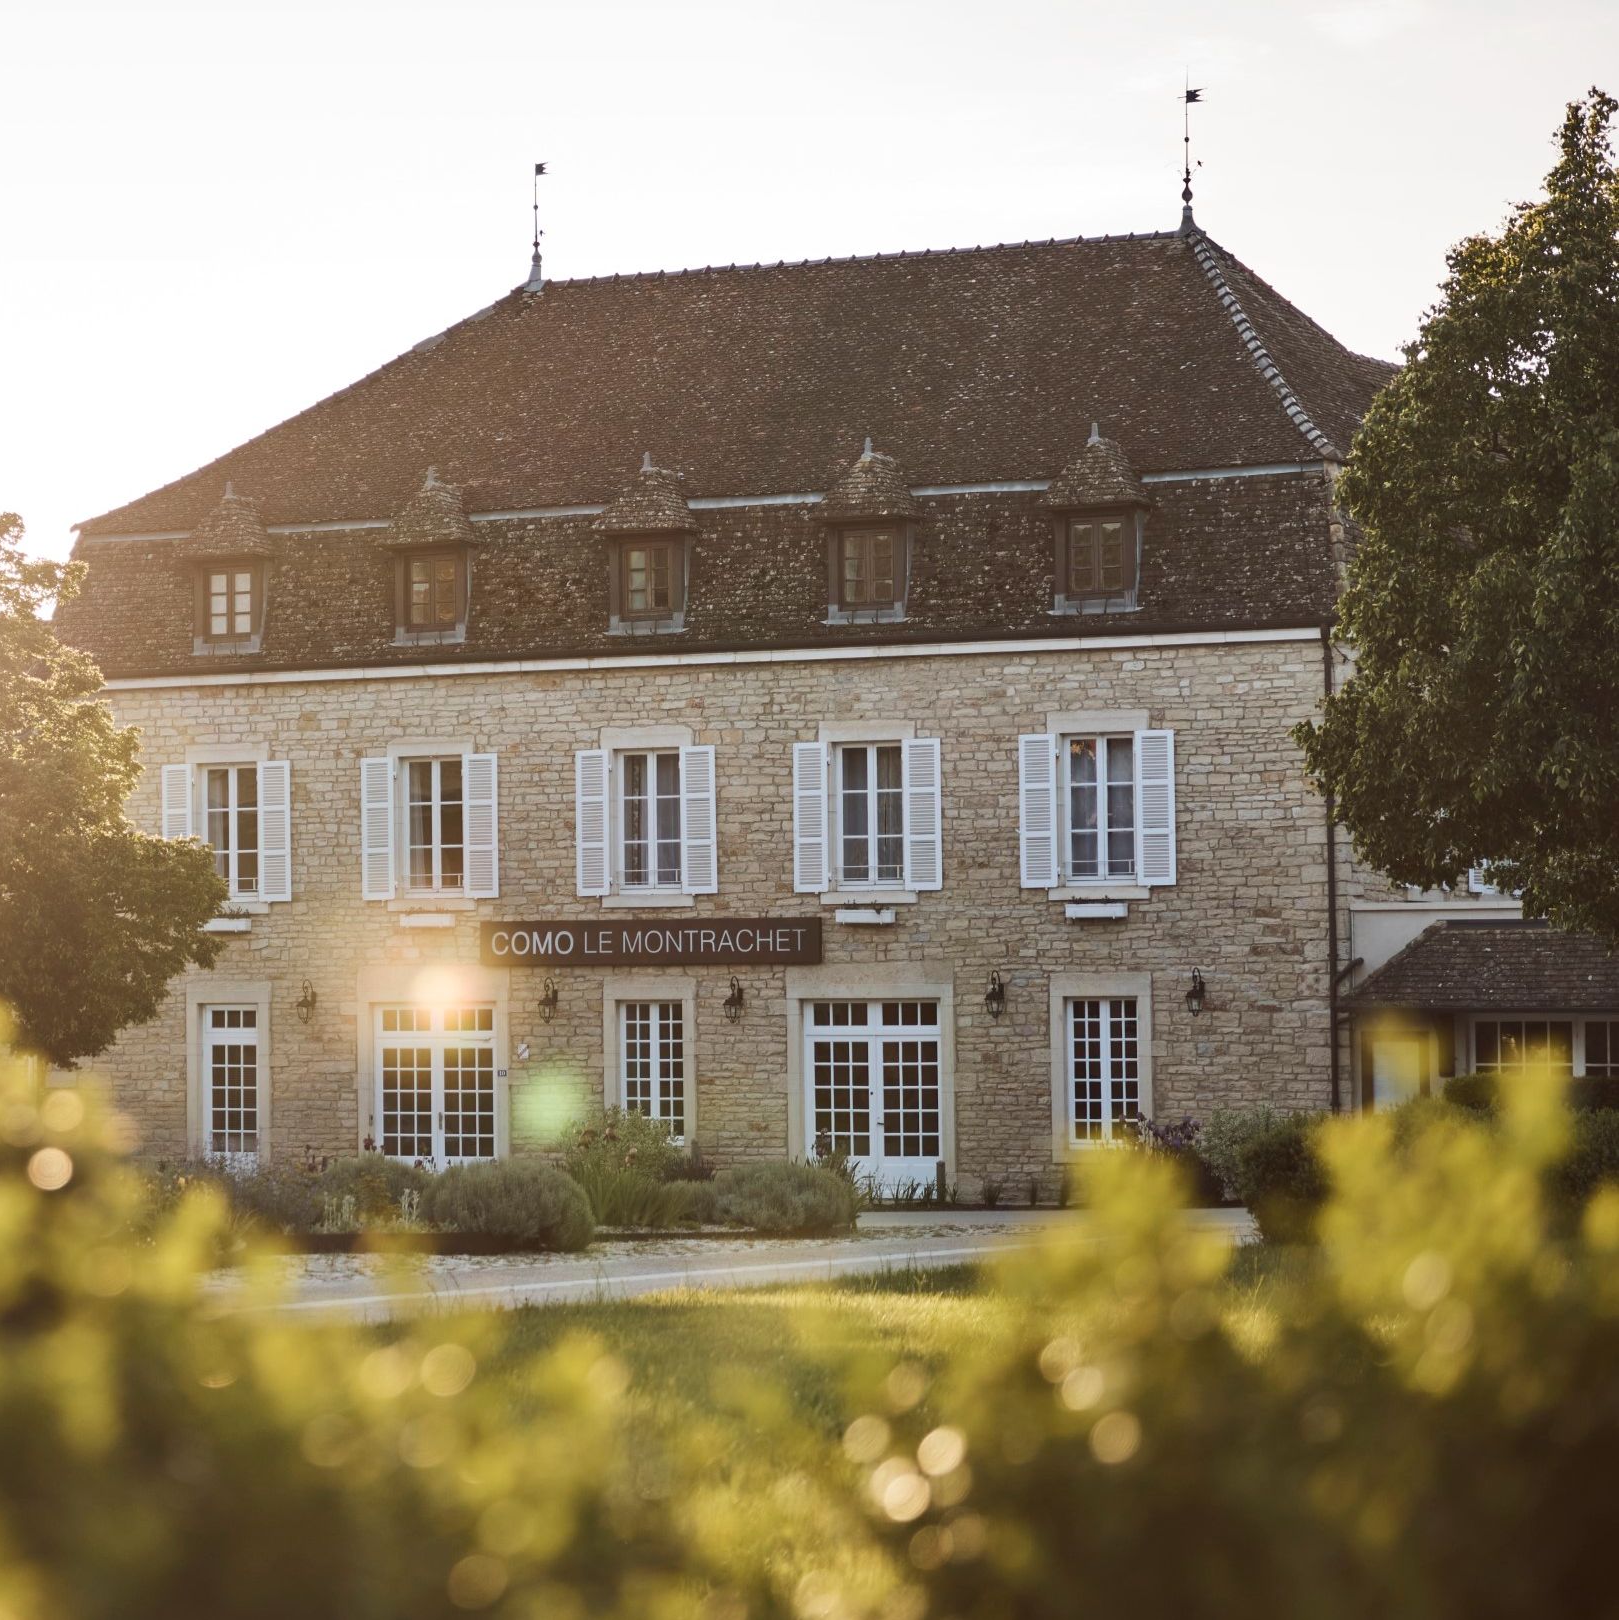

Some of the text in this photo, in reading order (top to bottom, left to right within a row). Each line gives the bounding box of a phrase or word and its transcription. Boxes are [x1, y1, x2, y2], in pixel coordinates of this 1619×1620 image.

[491, 928, 807, 956] COMO LE MONTRACHET
